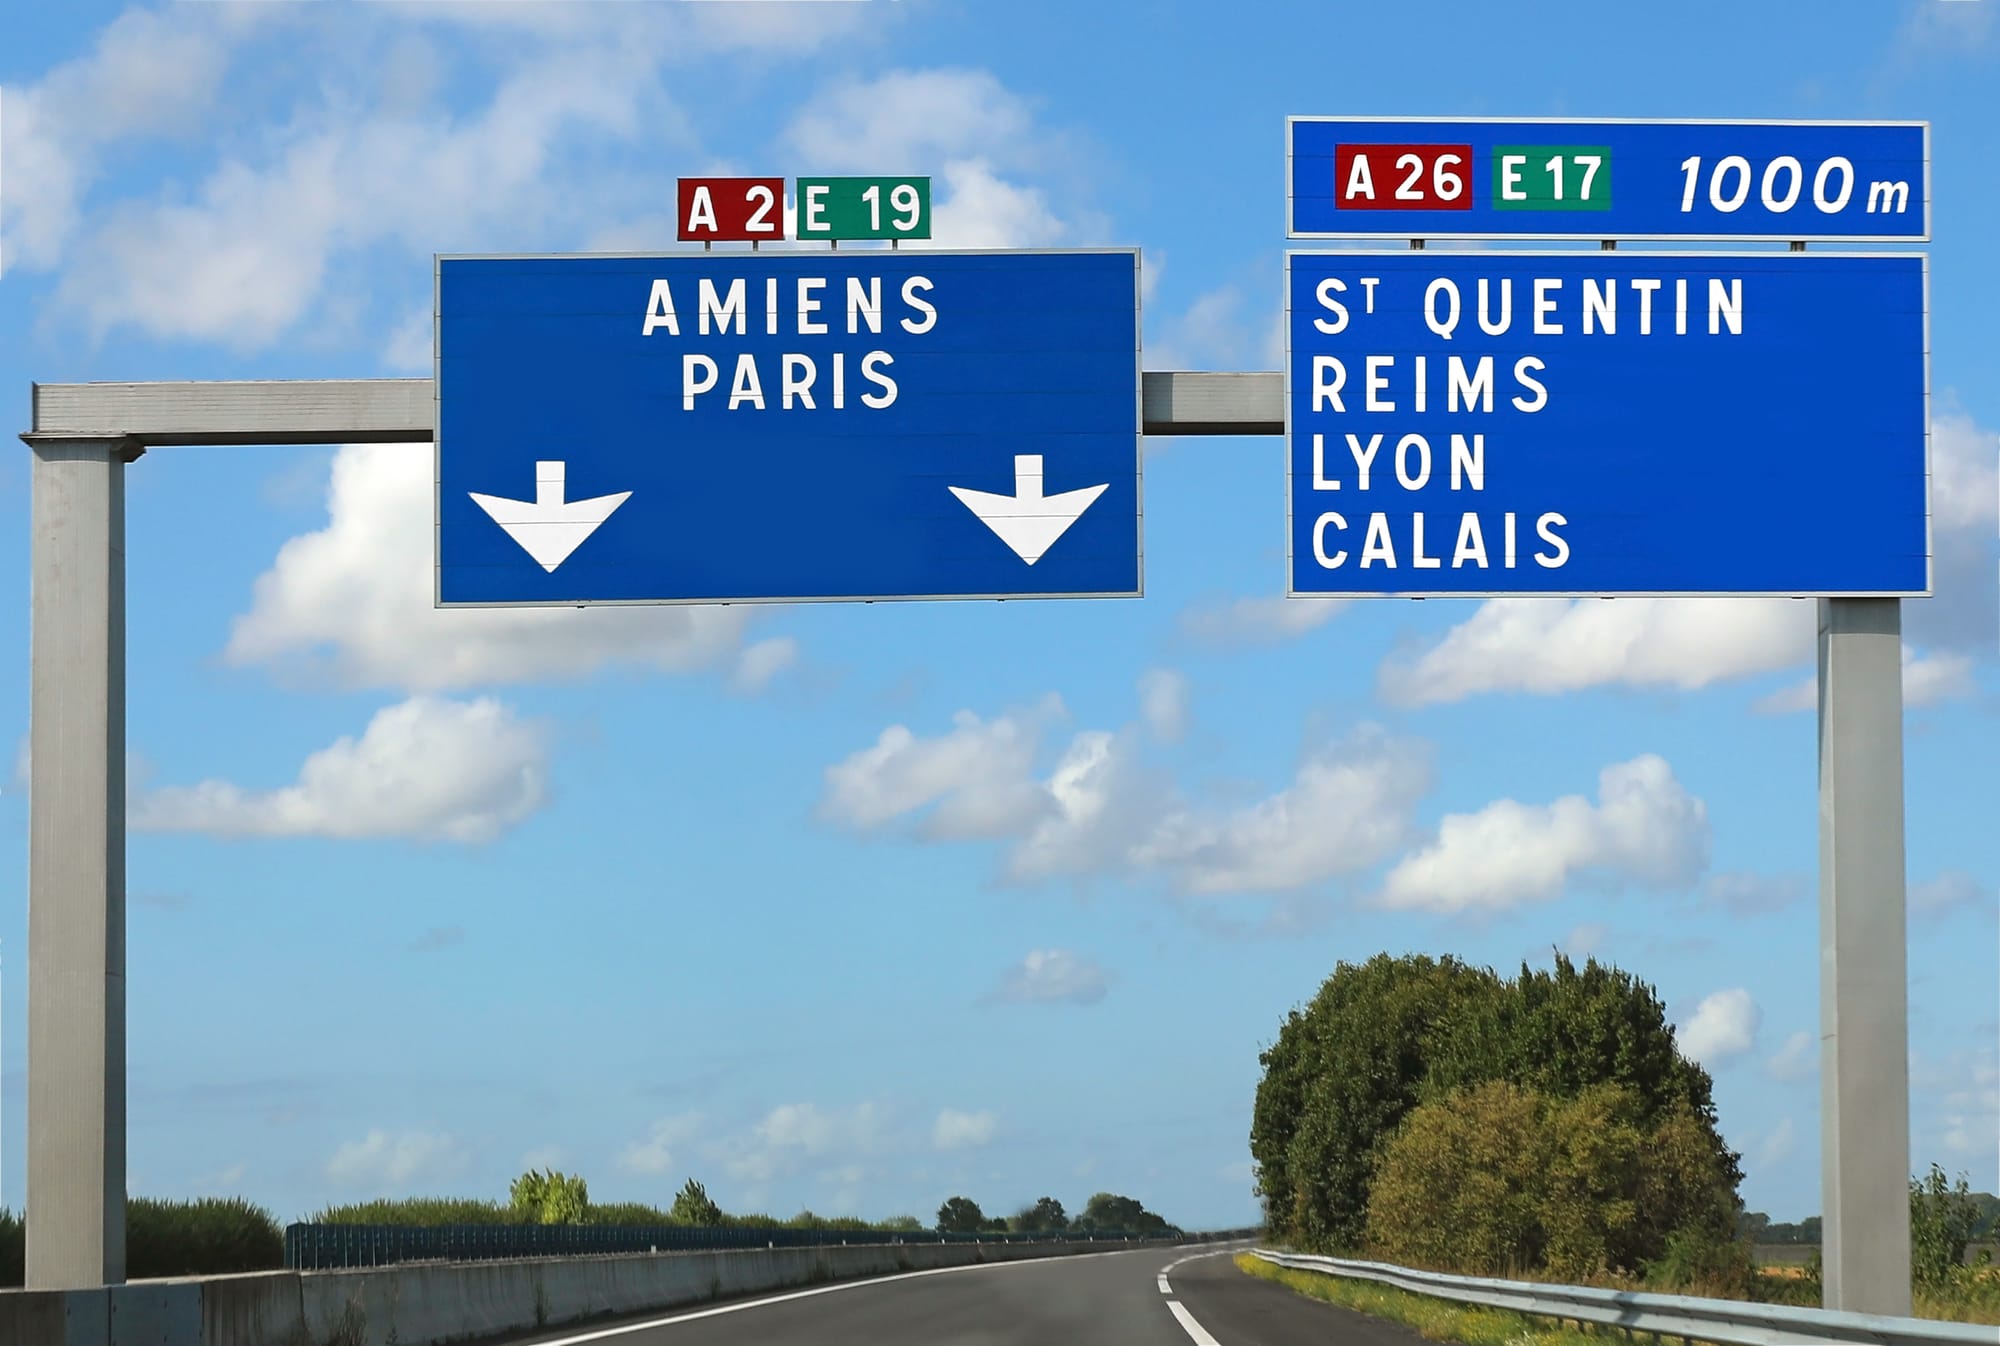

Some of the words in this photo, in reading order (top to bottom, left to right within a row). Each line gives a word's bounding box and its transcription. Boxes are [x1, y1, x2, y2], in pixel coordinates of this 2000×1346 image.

[1345, 154, 1375, 200] A
[1395, 153, 1463, 201] 26
[1502, 155, 1527, 201] E
[1545, 155, 1602, 201] 17
[1681, 155, 1854, 214] 1000
[1866, 181, 1909, 213] m
[687, 186, 718, 233] A
[744, 185, 775, 233] 2
[806, 185, 831, 231] E
[862, 184, 920, 231] 19
[642, 275, 937, 336] AMIENS
[1424, 277, 1742, 340] QUENTIN
[683, 350, 898, 411] PARIS
[1312, 355, 1548, 413] REIMS
[1312, 433, 1485, 491] LYON
[1312, 511, 1570, 569] CALAIS
